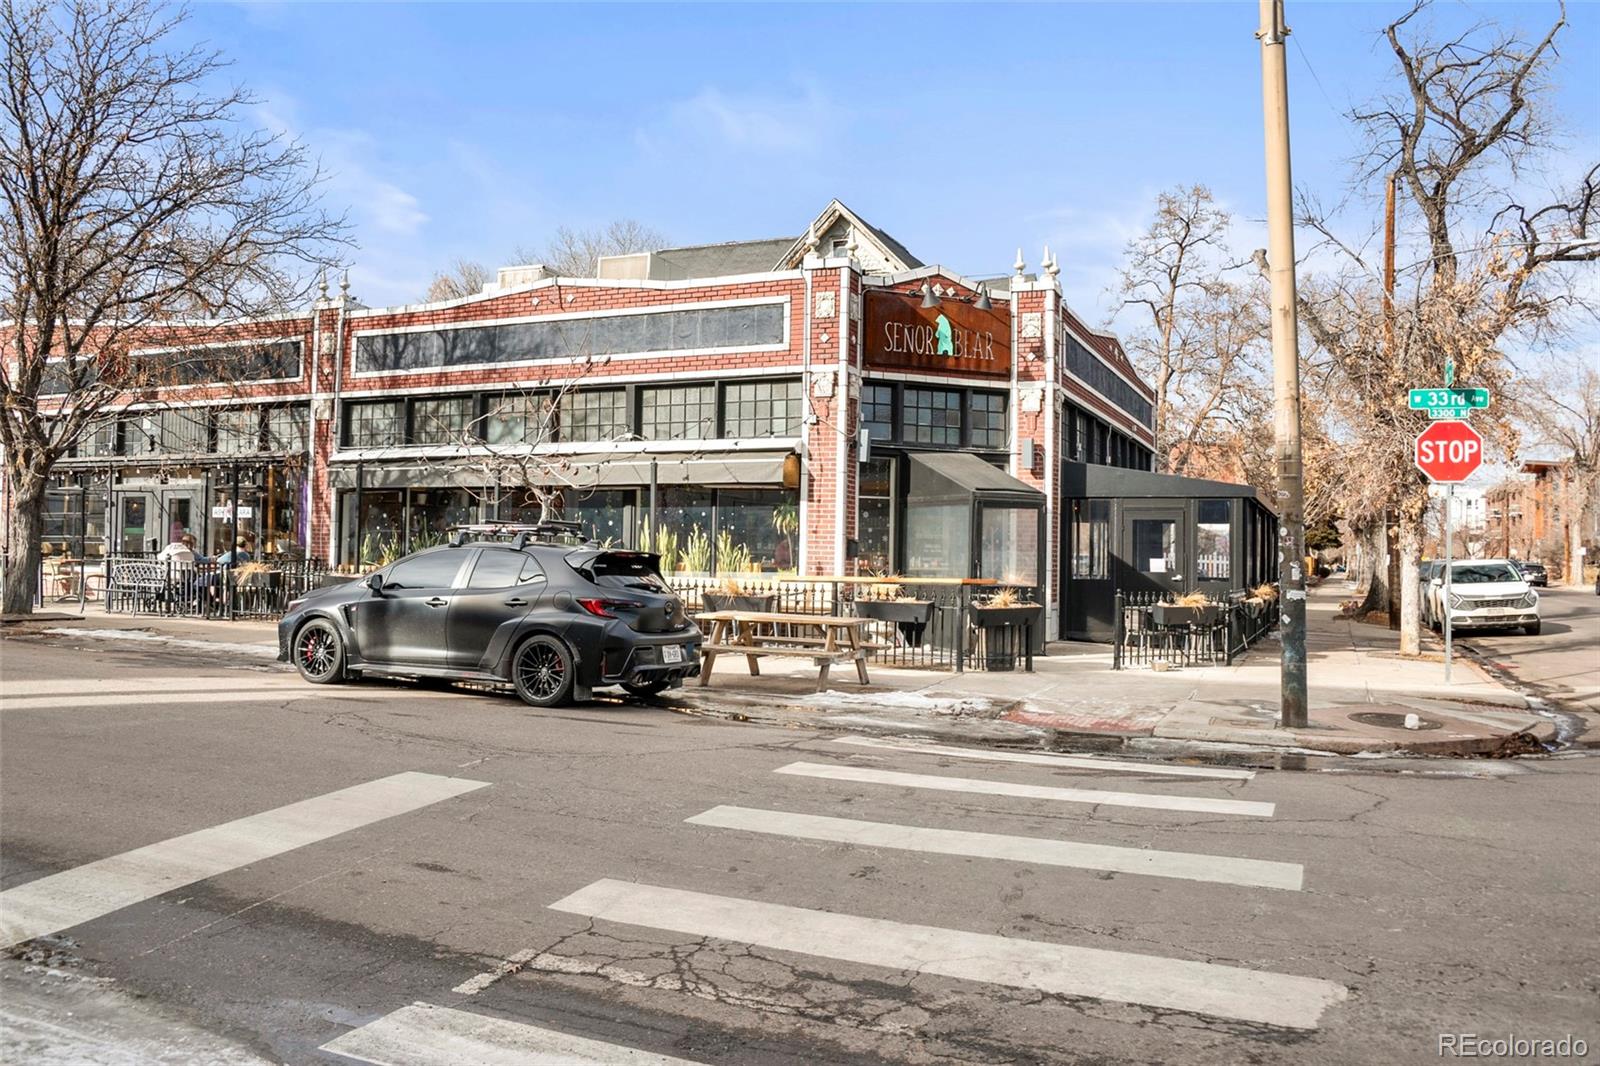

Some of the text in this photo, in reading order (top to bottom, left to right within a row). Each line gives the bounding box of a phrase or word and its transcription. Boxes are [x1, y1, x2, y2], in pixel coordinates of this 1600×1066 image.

[883, 321, 995, 361] SEÑOR BEAR
[1428, 392, 1466, 406] 33rd
[1431, 409, 1467, 417] 3300 N
[1420, 440, 1479, 464] STOP
